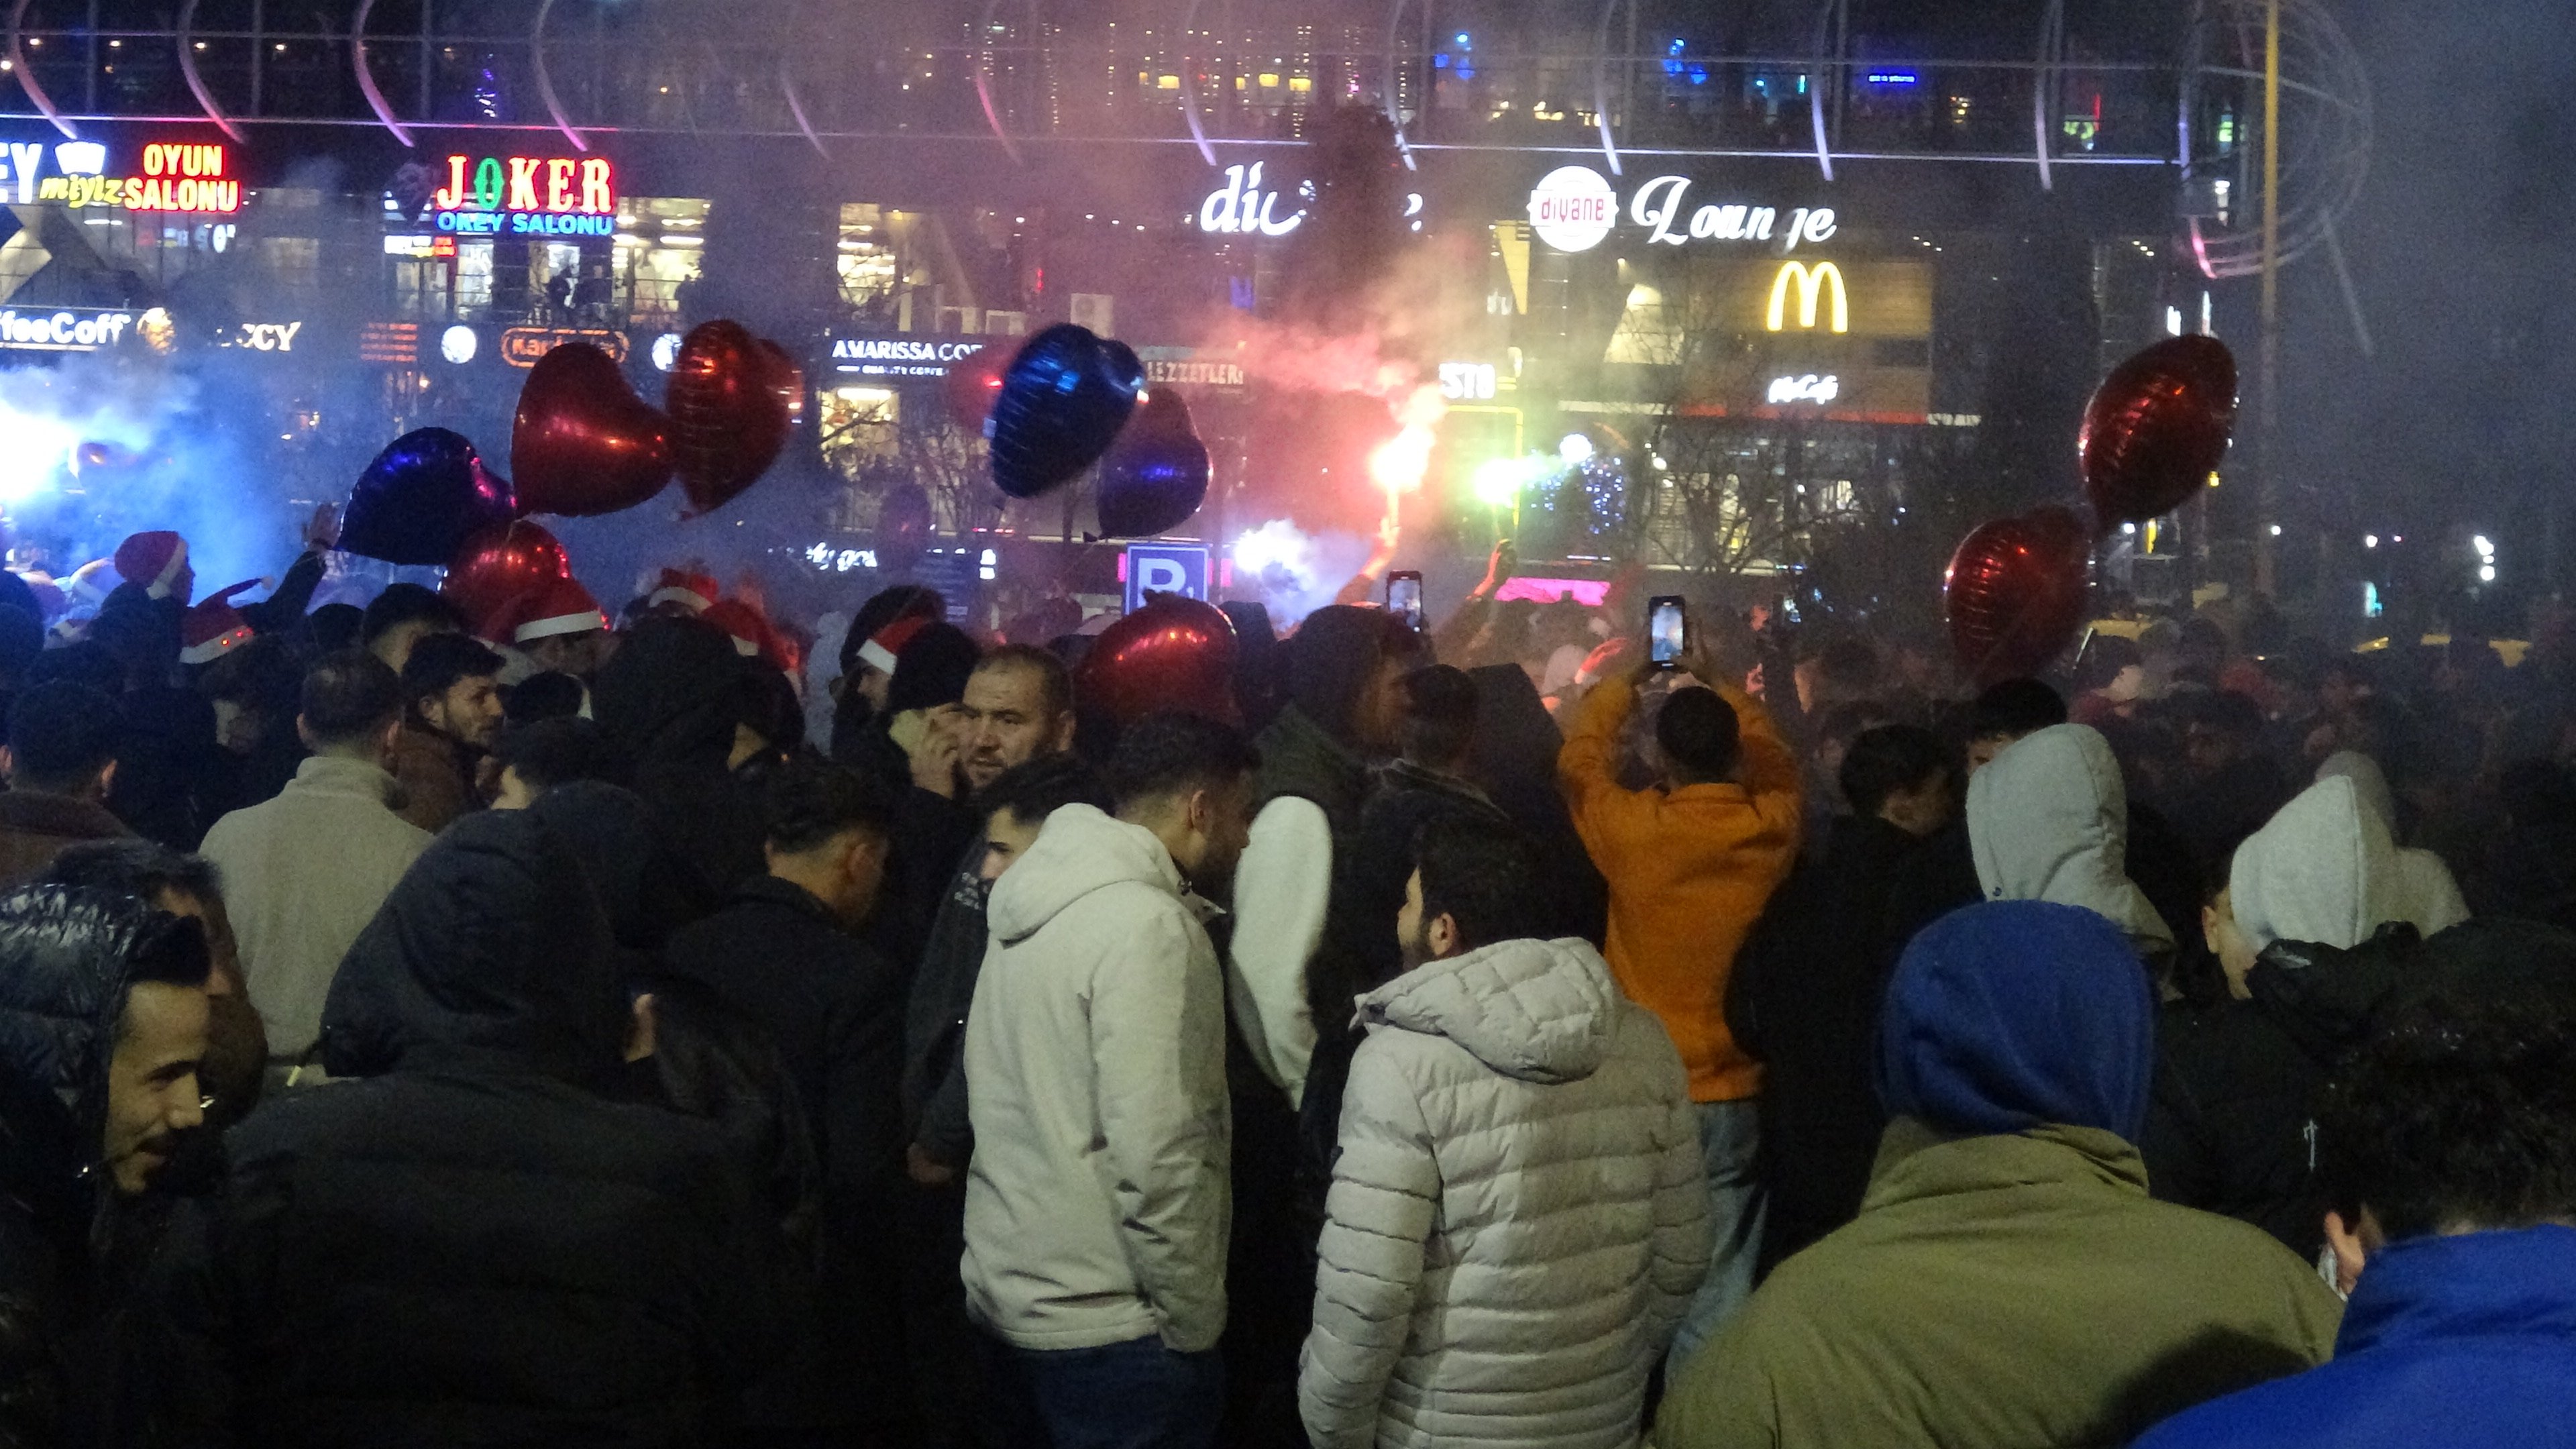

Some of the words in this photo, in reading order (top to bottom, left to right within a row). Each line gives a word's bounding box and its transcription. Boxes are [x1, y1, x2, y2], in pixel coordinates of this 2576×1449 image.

[144, 144, 223, 176] OYUN
[124, 177, 239, 211] SALONU
[437, 155, 612, 215] JOKER
[437, 211, 506, 232] OKEY
[512, 213, 614, 235] SALONU
[1541, 197, 1604, 223] divane
[832, 340, 936, 360] AMARISSA
